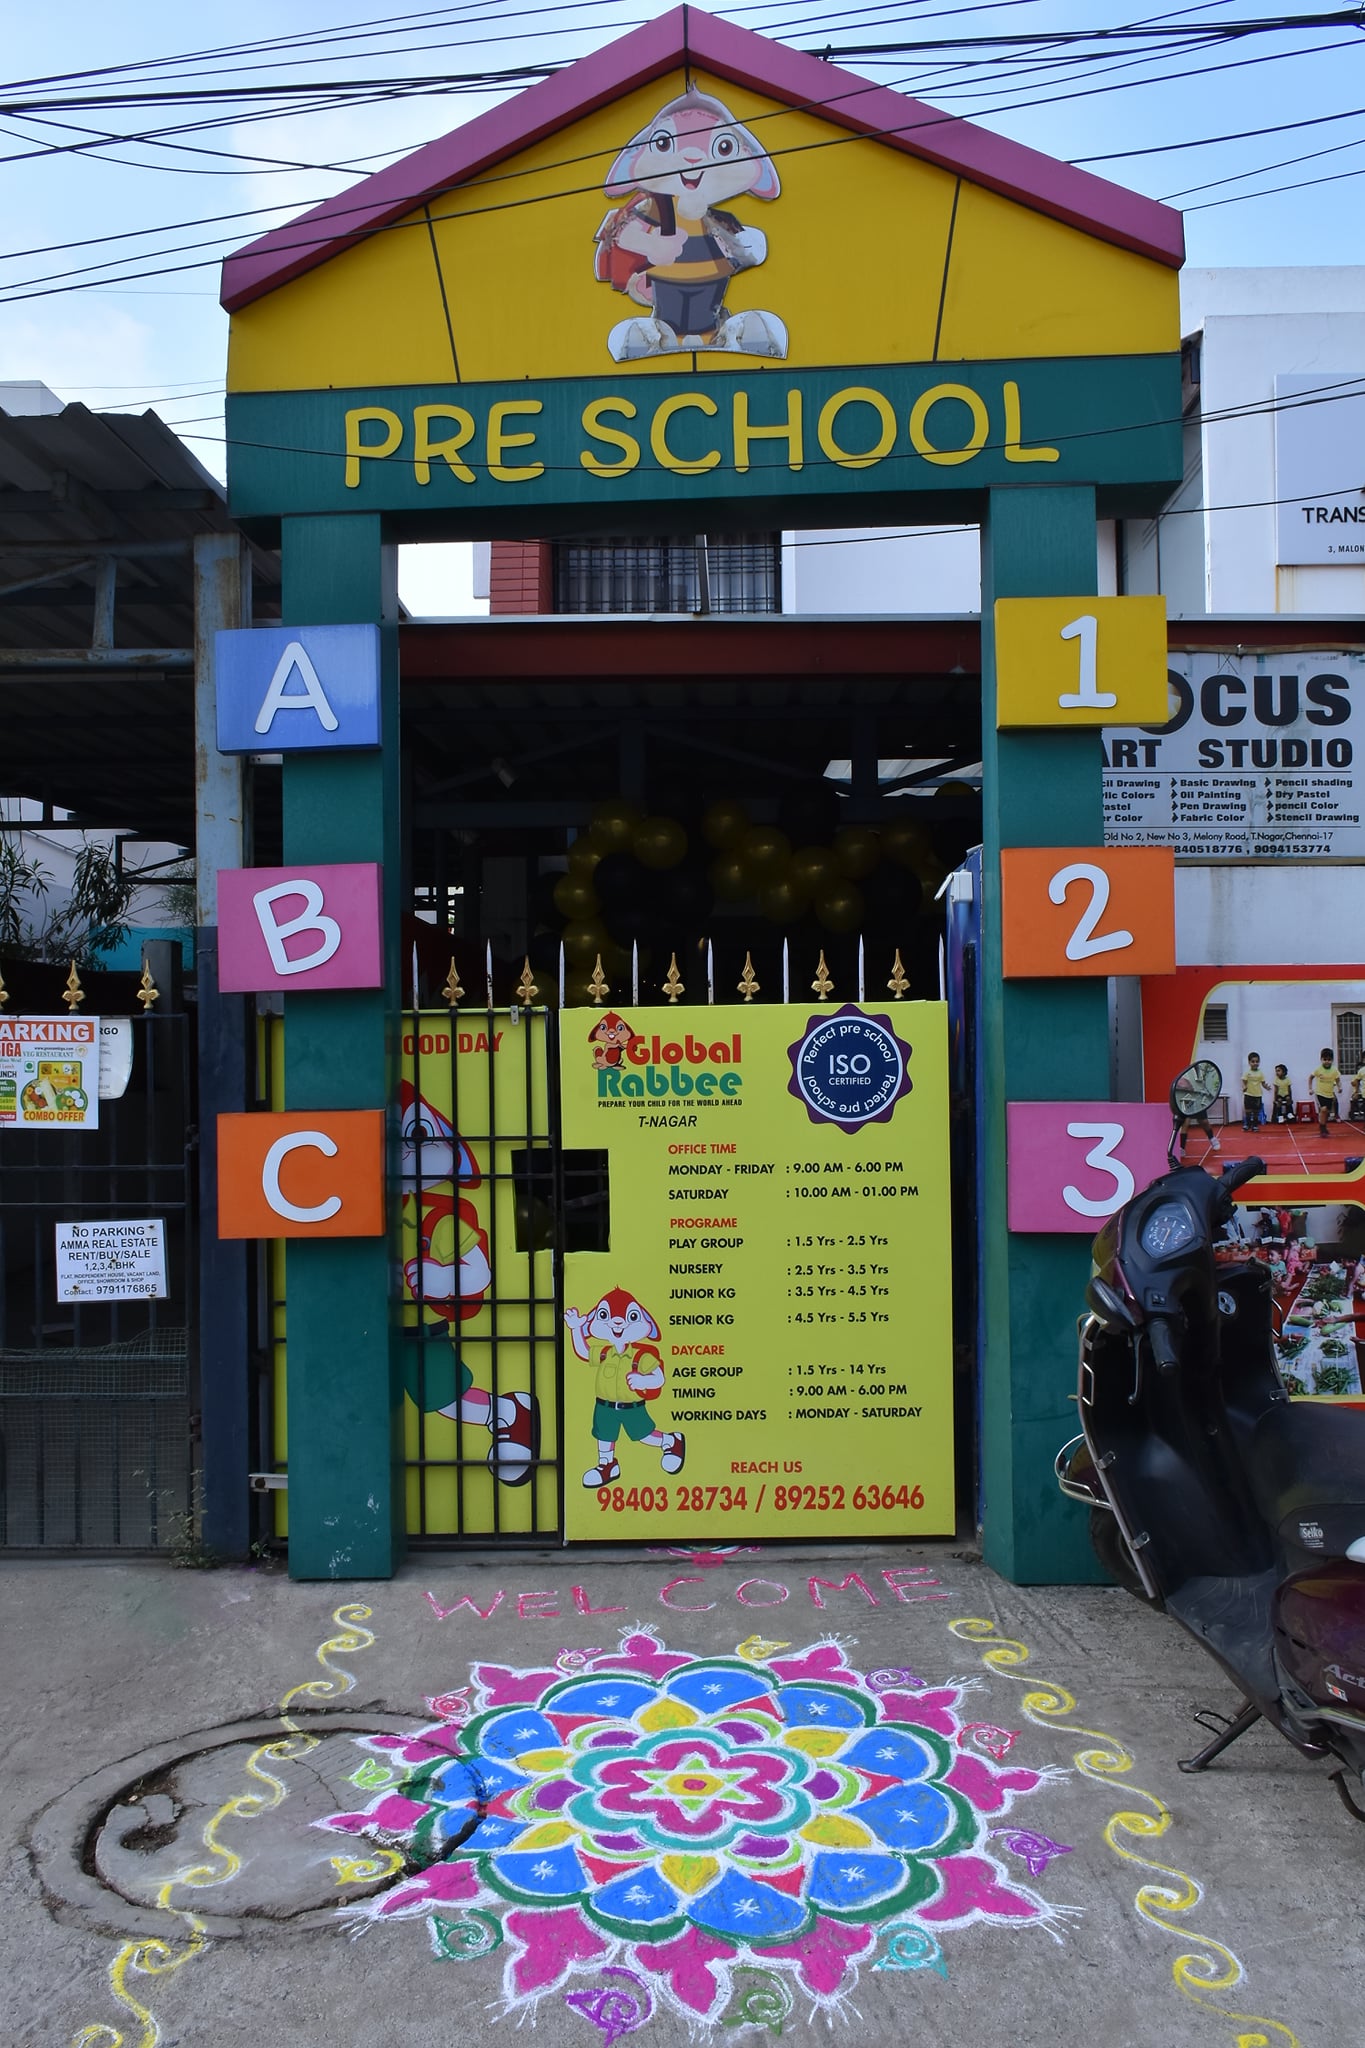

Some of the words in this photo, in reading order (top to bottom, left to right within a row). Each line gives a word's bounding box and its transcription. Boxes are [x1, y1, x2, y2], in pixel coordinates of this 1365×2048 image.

[344, 399, 545, 489] PRE
[580, 381, 1060, 478] SCHOOL
[1328, 546, 1336, 554] 3,
[1338, 544, 1365, 552] MALON
[1059, 615, 1117, 709] 1
[254, 641, 339, 735] A
[1198, 738, 1353, 768] STUDIO
[1116, 780, 1160, 788] Drawing
[1180, 779, 1208, 787] Basic
[1212, 779, 1256, 788] Drawing
[1311, 779, 1353, 788] shading
[1198, 791, 1241, 800] Painting
[1275, 791, 1294, 800] Dry
[1180, 802, 1200, 810] Pen
[1202, 802, 1246, 812] Drawing
[1275, 802, 1307, 811] pencil
[1114, 814, 1142, 822] Color
[1316, 814, 1359, 823] Drawing
[1104, 832, 1118, 840] Old
[1136, 833, 1144, 842] 2,
[1182, 833, 1191, 842] 3,
[1194, 832, 1222, 842] Melony
[1225, 832, 1249, 841] Road,
[1168, 845, 1242, 853] 840518776
[1254, 845, 1330, 853] 9094153774
[1048, 863, 1134, 962] 2
[253, 879, 342, 976] B
[458, 1032, 504, 1054] DAY
[804, 1027, 836, 1064] Perfect
[840, 1025, 860, 1037] pre
[864, 1028, 896, 1062] school
[626, 1034, 742, 1065] Global
[830, 1054, 871, 1075] ISO
[598, 1066, 742, 1097] Rabbee
[828, 1077, 871, 1086] CERTIFIED
[804, 1076, 836, 1109] school
[864, 1074, 896, 1112] Perfect
[840, 1101, 860, 1112] pre
[24, 1111, 55, 1120] COMBO
[57, 1111, 84, 1120] OFFER
[638, 1116, 697, 1127] T-NAGAR
[668, 1144, 706, 1154] OFFICE
[710, 1144, 736, 1153] TIME
[669, 1165, 723, 1175] MONDAY
[734, 1164, 775, 1174] FRIDAY
[793, 1163, 820, 1173] 9.00
[823, 1163, 843, 1172] AM
[855, 1162, 881, 1172] 6.00
[885, 1162, 903, 1171] PM
[1062, 1122, 1136, 1218] 3
[262, 1131, 342, 1223] C
[668, 1189, 728, 1200] SATURDAY
[795, 1187, 828, 1197] 10.00
[831, 1187, 851, 1197] AM
[863, 1186, 896, 1196] 01.00
[900, 1186, 918, 1196] PM
[670, 1218, 737, 1228] PROGRAME
[72, 1228, 89, 1237] NO
[92, 1227, 145, 1236] PARKING
[60, 1240, 90, 1249] AMMA
[92, 1240, 118, 1248] REAL
[121, 1238, 158, 1247] ESTATE
[669, 1239, 697, 1248] PLAY
[701, 1238, 744, 1248] GROUP
[796, 1236, 812, 1246] 1.5
[817, 1236, 835, 1246] Yrs
[848, 1236, 865, 1245] 2.5
[870, 1235, 888, 1245] Yrs
[69, 1250, 150, 1260] RENT/BUY/SALE
[669, 1264, 723, 1274] NURSERY
[795, 1265, 813, 1275] 2.5
[818, 1265, 836, 1275] Yrs
[848, 1264, 866, 1274] 3.5
[870, 1264, 888, 1274] Yrs
[96, 1284, 157, 1294] 9791176865
[669, 1289, 714, 1299] JUNIOR
[718, 1288, 736, 1298] KG
[795, 1286, 814, 1296] 3.5
[818, 1286, 836, 1296] Yrs
[848, 1285, 866, 1296] 4.5
[870, 1285, 889, 1295] Yrs
[669, 1315, 712, 1326] SENIOR
[716, 1314, 734, 1325] KG
[795, 1313, 814, 1323] 4.5
[818, 1313, 836, 1322] Yrs
[848, 1312, 866, 1322] 5.5
[870, 1312, 889, 1322] Yrs
[672, 1345, 725, 1355] DAYCARE
[672, 1368, 696, 1377] AGE
[700, 1367, 743, 1377] GROUP
[797, 1365, 814, 1375] 1.5
[819, 1365, 837, 1375] Yrs
[850, 1365, 864, 1374] 14
[868, 1364, 886, 1374] Yrs
[672, 1388, 716, 1398] TIMING
[797, 1386, 823, 1396] 9.00
[827, 1386, 847, 1395] AM
[859, 1385, 885, 1395] 6.00
[889, 1385, 907, 1394] PM
[671, 1410, 732, 1421] WORKING
[736, 1410, 766, 1420] DAYS
[795, 1408, 850, 1418] MONDAY
[862, 1407, 922, 1417] SATURDAY
[731, 1461, 779, 1473] REACH
[783, 1461, 803, 1473] US
[597, 1486, 668, 1512] 98403
[676, 1486, 748, 1511] 28734
[774, 1485, 845, 1511] 89252
[852, 1485, 924, 1510] 63646
